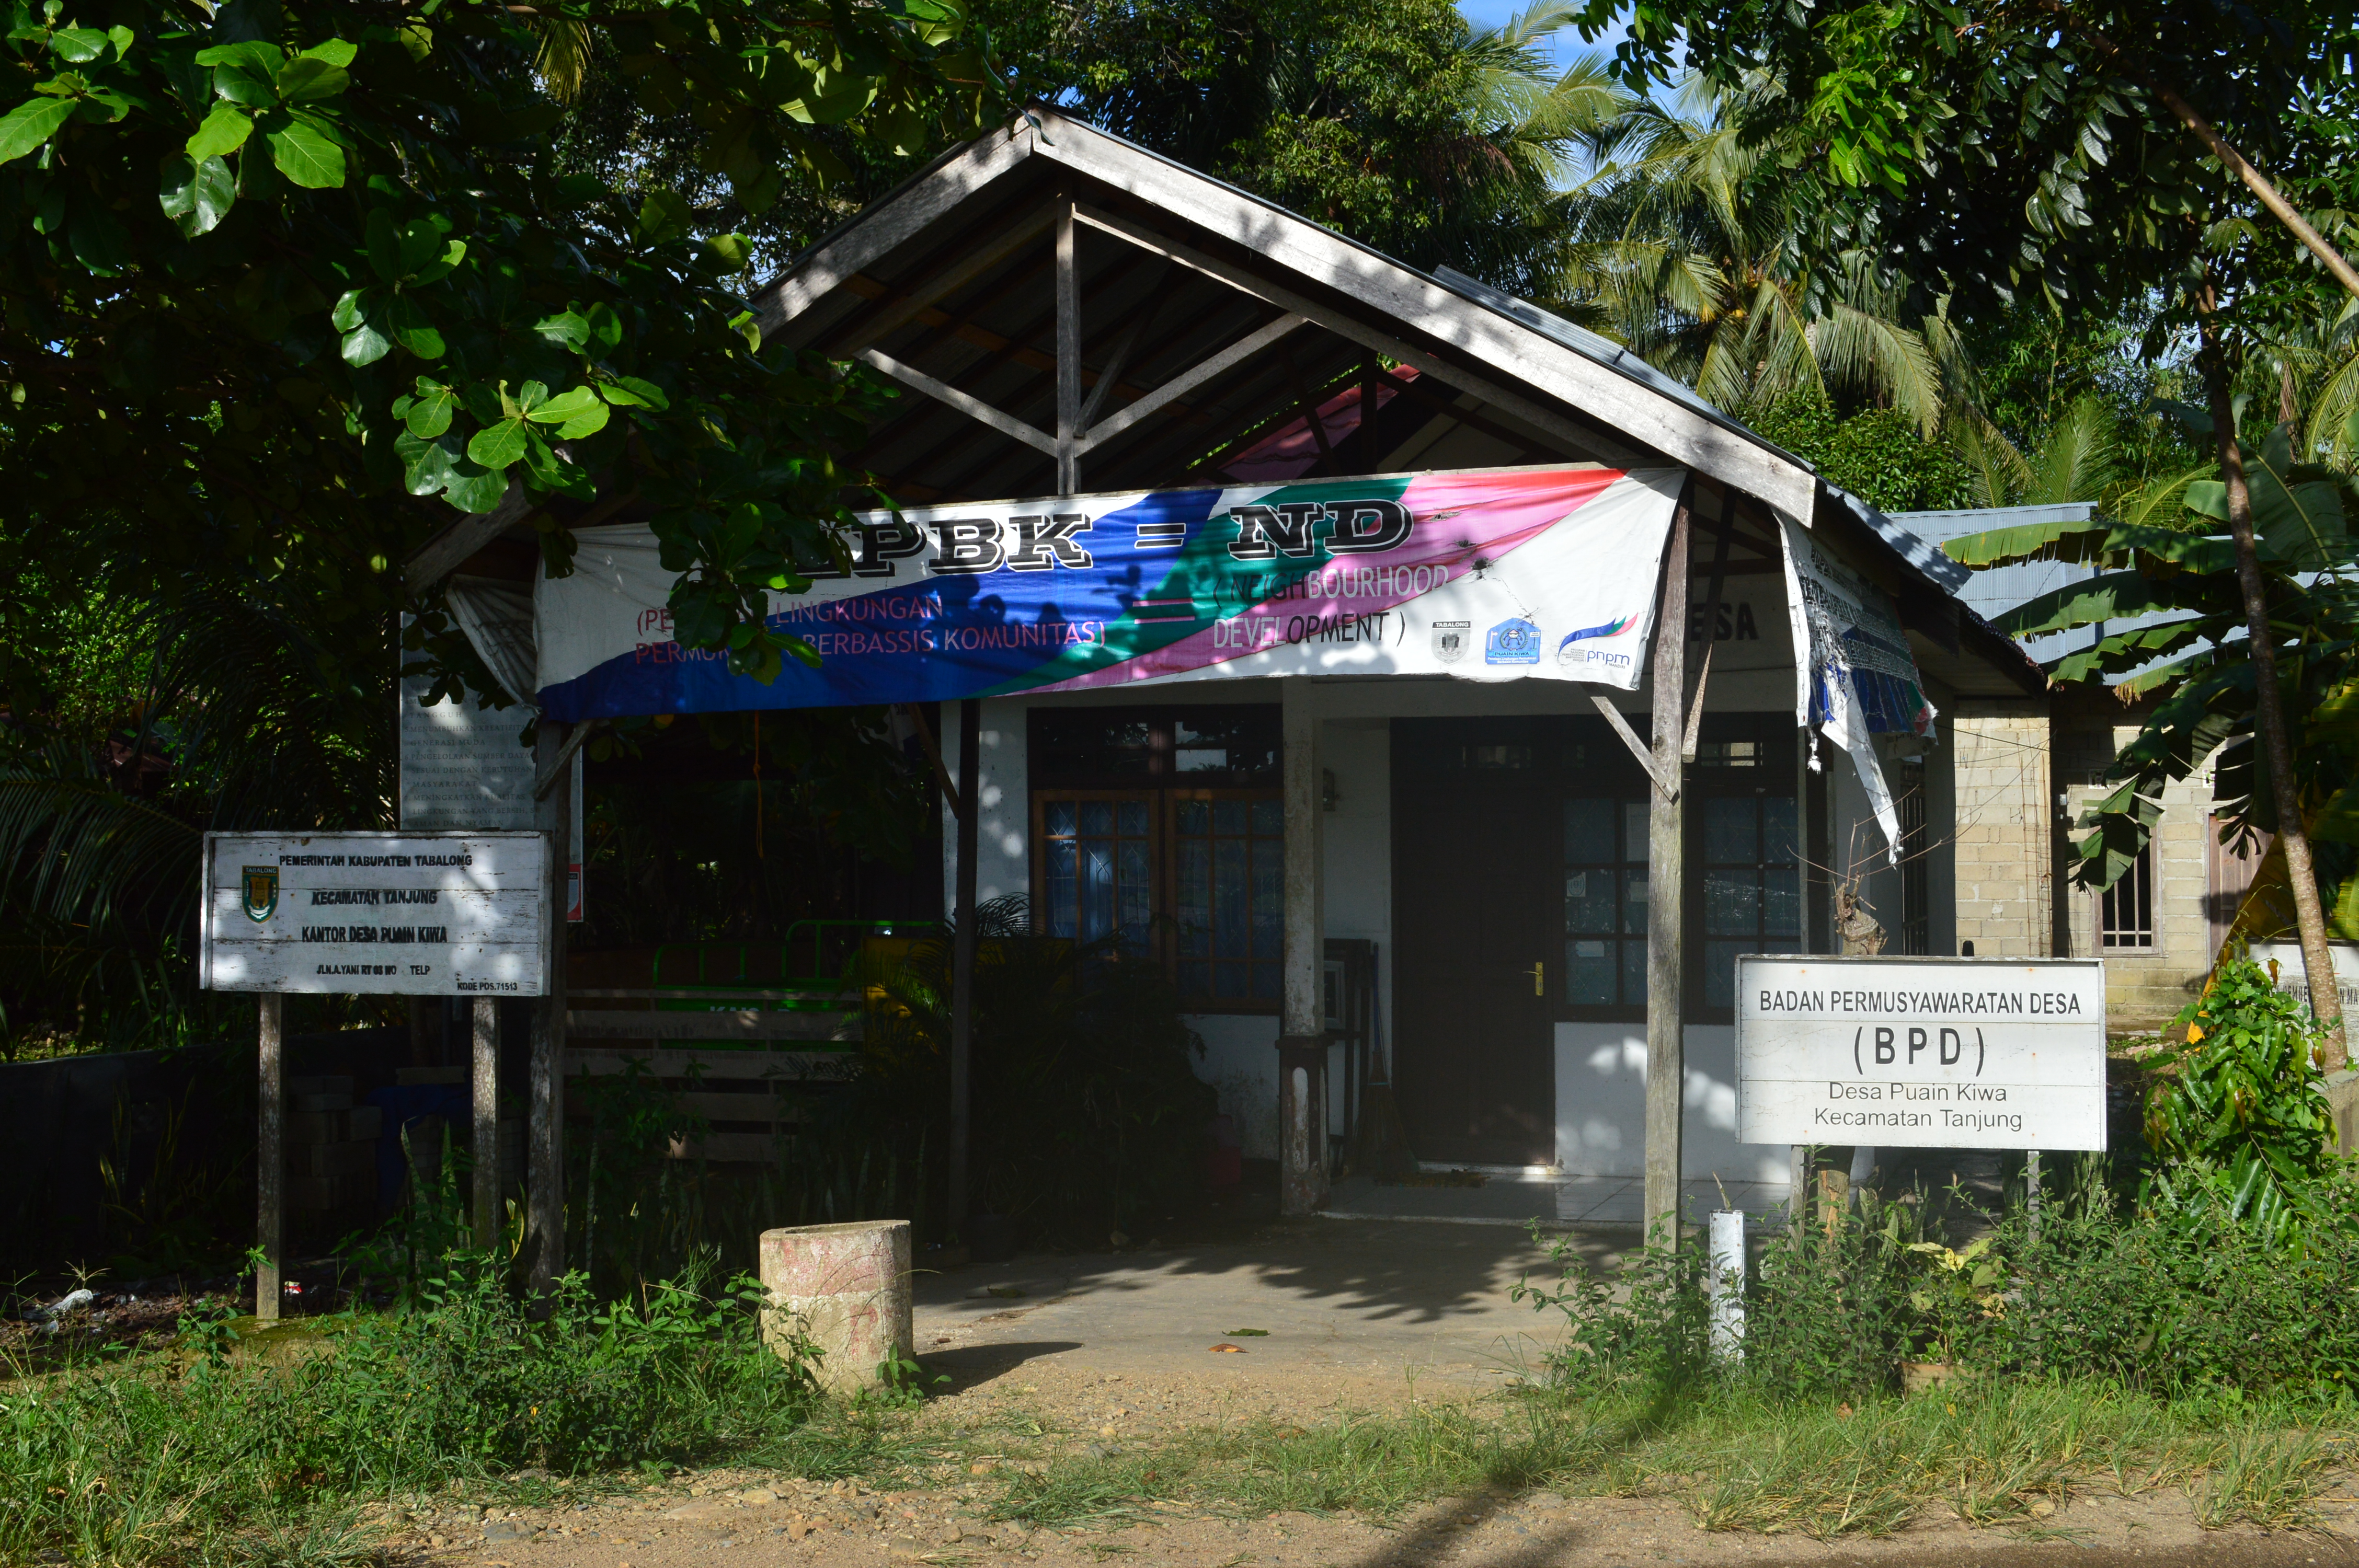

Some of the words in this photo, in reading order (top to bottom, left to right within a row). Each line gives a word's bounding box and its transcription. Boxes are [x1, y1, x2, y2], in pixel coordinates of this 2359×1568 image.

[1229, 500, 1413, 560] ND
[777, 595, 943, 624] LINGKUNGAN
[1215, 612, 1390, 648] DEVELOPMENT
[1690, 602, 1759, 641] ESA
[803, 629, 934, 655] BERBASSIS
[945, 620, 1105, 651] KOMUNITAS)
[1587, 650, 1630, 666] pnpm
[279, 856, 345, 867] PEMERINTAH
[349, 856, 410, 867] KABUPATEN
[415, 855, 472, 867] TABALONG
[312, 890, 379, 905] KECAMATAN
[384, 890, 438, 905] TANJUNG
[302, 926, 346, 942] KANTOR
[349, 926, 377, 942] DESA
[382, 927, 415, 943] PUAIN
[418, 927, 448, 942] KIWA
[362, 965, 372, 975] RT
[410, 965, 430, 975] TELP
[457, 982, 477, 990] KODE
[1760, 990, 1823, 1011] BADAN
[1831, 990, 2023, 1014] PERMUSYAWARATAN
[2030, 993, 2081, 1014] DESA
[1829, 1082, 1882, 1101] Desa
[1891, 1083, 1949, 1101] Puain
[1957, 1083, 2007, 1102] Kiwa
[1814, 1108, 1932, 1127] Kecamatan
[1940, 1109, 2022, 1132] Tanjung
